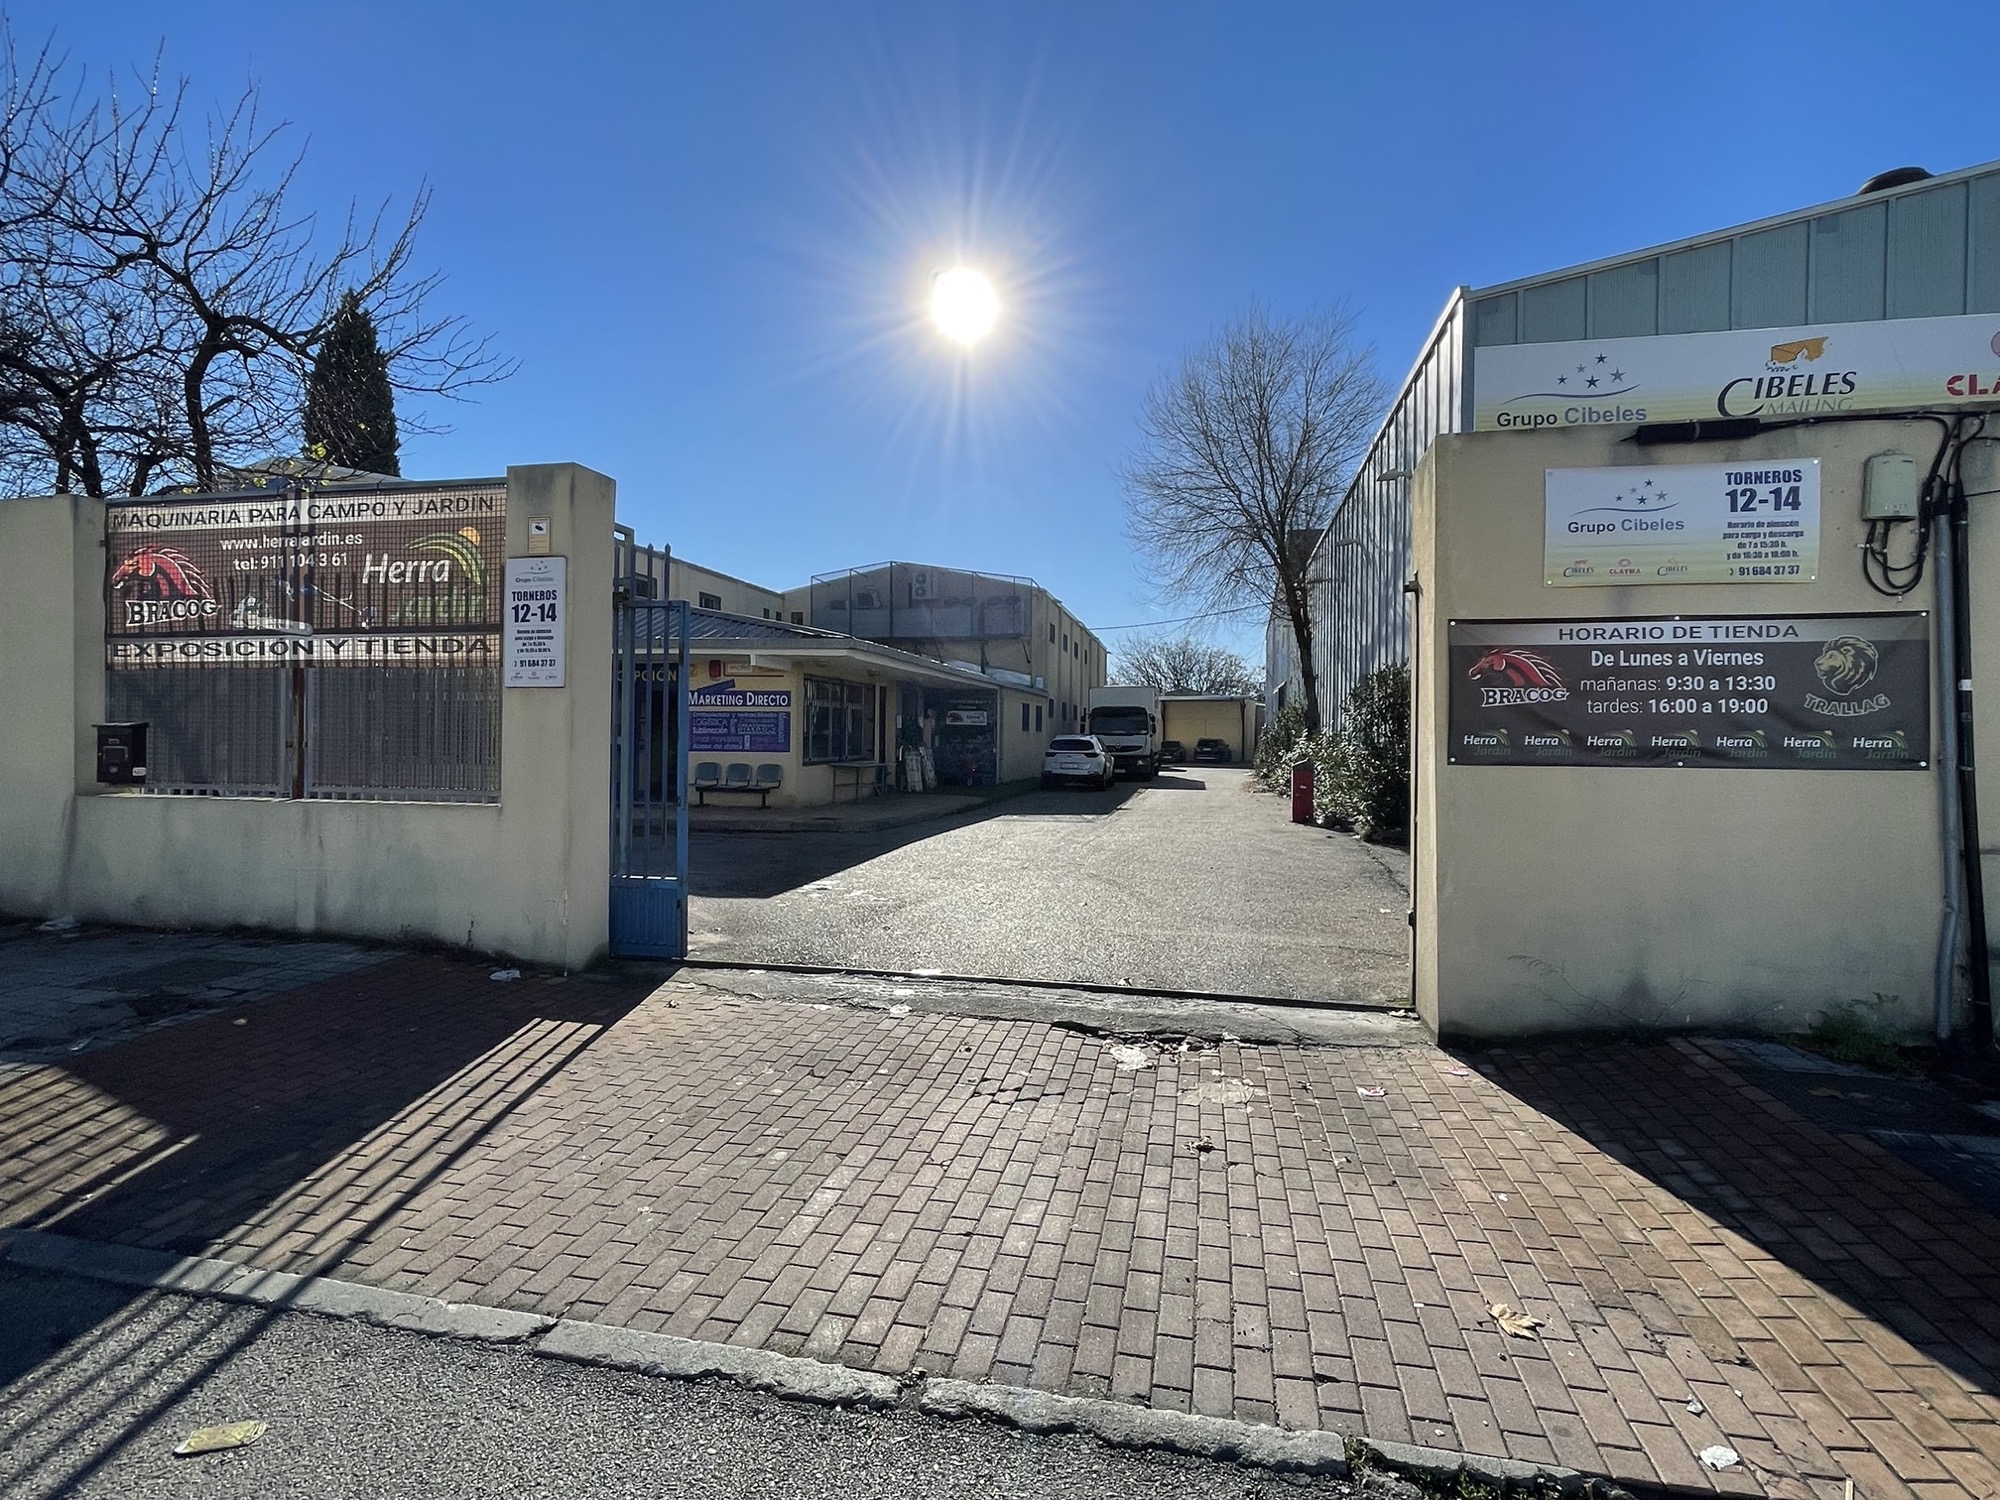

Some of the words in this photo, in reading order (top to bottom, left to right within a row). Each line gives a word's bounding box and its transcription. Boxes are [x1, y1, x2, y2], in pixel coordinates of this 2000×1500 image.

[1717, 371, 1856, 417] CIBELES
[1496, 412, 1557, 430] Grupo
[1564, 405, 1648, 424] Cibeles
[1725, 469, 1802, 485] TORNEROS
[1725, 486, 1801, 513] 12-14
[113, 510, 241, 529] MAQUINARIA
[250, 507, 300, 523] PARA
[307, 502, 385, 519] CAMPO
[394, 501, 406, 515] Y
[412, 494, 493, 515] JARDÍN
[1567, 522, 1616, 536] Grupo
[1621, 519, 1685, 532] Cibeles
[220, 531, 363, 550] www.herrajardin.es
[290, 553, 315, 567] 104
[362, 553, 450, 584] Herra
[1738, 567, 1750, 576] 91
[1752, 566, 1772, 576] 684
[1774, 566, 1786, 575] 37
[1788, 565, 1800, 575] 37
[512, 590, 557, 601] TORNEROS
[125, 600, 222, 626] BRACOG
[512, 603, 557, 623] 12-14
[1558, 626, 1665, 641] HORARIO
[1673, 626, 1702, 639] DE
[1708, 625, 1799, 639] TIENDA
[114, 637, 313, 658] EXPOSICIÓN
[326, 639, 348, 655] Y
[358, 638, 492, 655] TIENDA
[1591, 651, 1615, 667] De
[1619, 650, 1673, 667] Lunes
[1678, 654, 1688, 666] a
[1693, 649, 1764, 666] Viernes
[1580, 677, 1661, 691] mañanas:
[1666, 676, 1705, 691] 9:30
[1709, 679, 1720, 691] a
[1726, 676, 1776, 691] 13:30
[689, 691, 743, 706] MARKETING
[746, 692, 789, 706] DIRECTO
[1481, 687, 1570, 708] BRACOG
[1804, 693, 1891, 717] TRALLAG
[1587, 699, 1643, 713] tardes:
[1649, 699, 1697, 713] 16:00
[1702, 702, 1712, 713] a
[1718, 699, 1769, 713] 19:00
[1464, 735, 1497, 745] Herra
[1525, 735, 1559, 746] Herra
[1587, 736, 1622, 746] Herra
[1651, 736, 1687, 747] Herra
[1716, 736, 1752, 747] Herra
[1783, 737, 1820, 748] Herra
[1853, 737, 1892, 748] Herra
